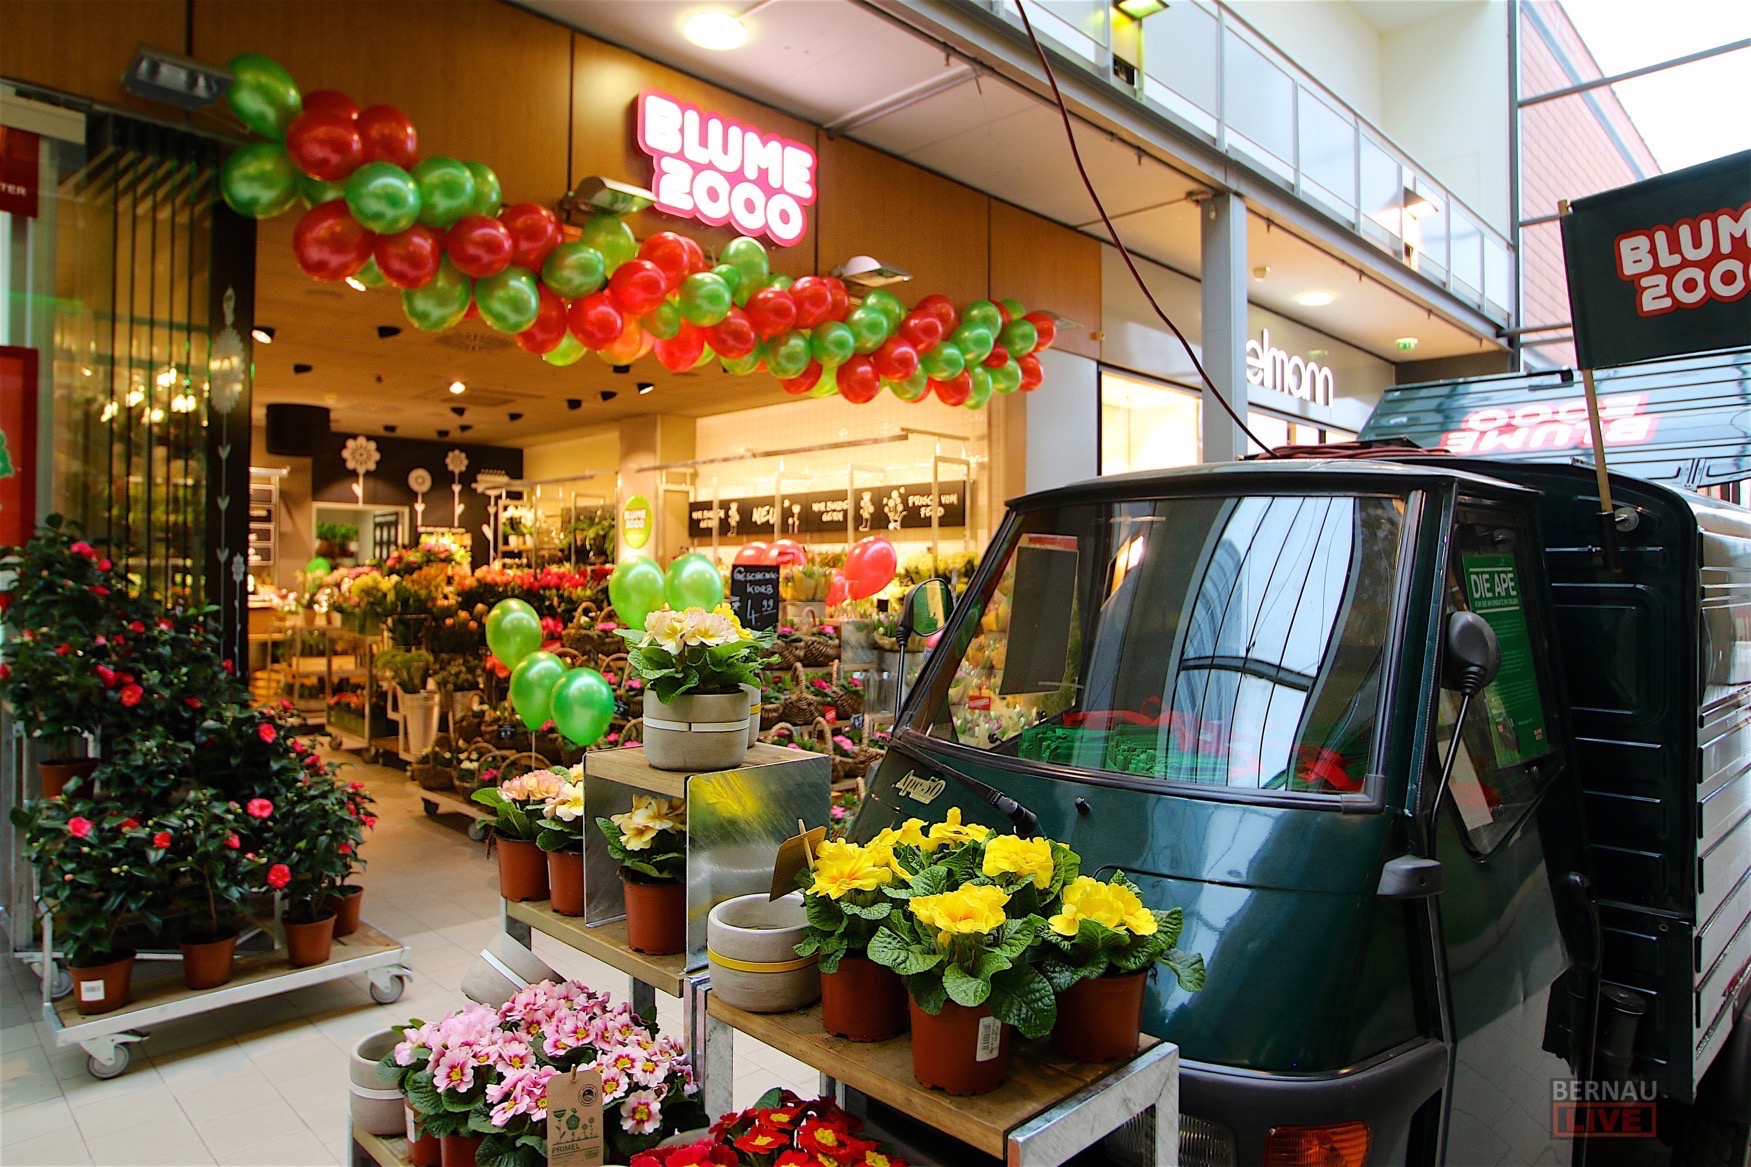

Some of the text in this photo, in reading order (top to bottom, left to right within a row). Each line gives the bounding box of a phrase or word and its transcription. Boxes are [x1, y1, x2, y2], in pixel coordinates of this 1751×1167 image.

[645, 95, 813, 199] BLUME
[659, 156, 803, 240] 2000
[1619, 207, 1751, 276] BLUM
[1640, 258, 1751, 312] 200
[908, 493, 958, 508] FRISC VOM
[920, 506, 945, 519] FED
[752, 505, 776, 526] NEU
[1470, 572, 1518, 599] DIE APE
[551, 1143, 581, 1155] PRIMEL
